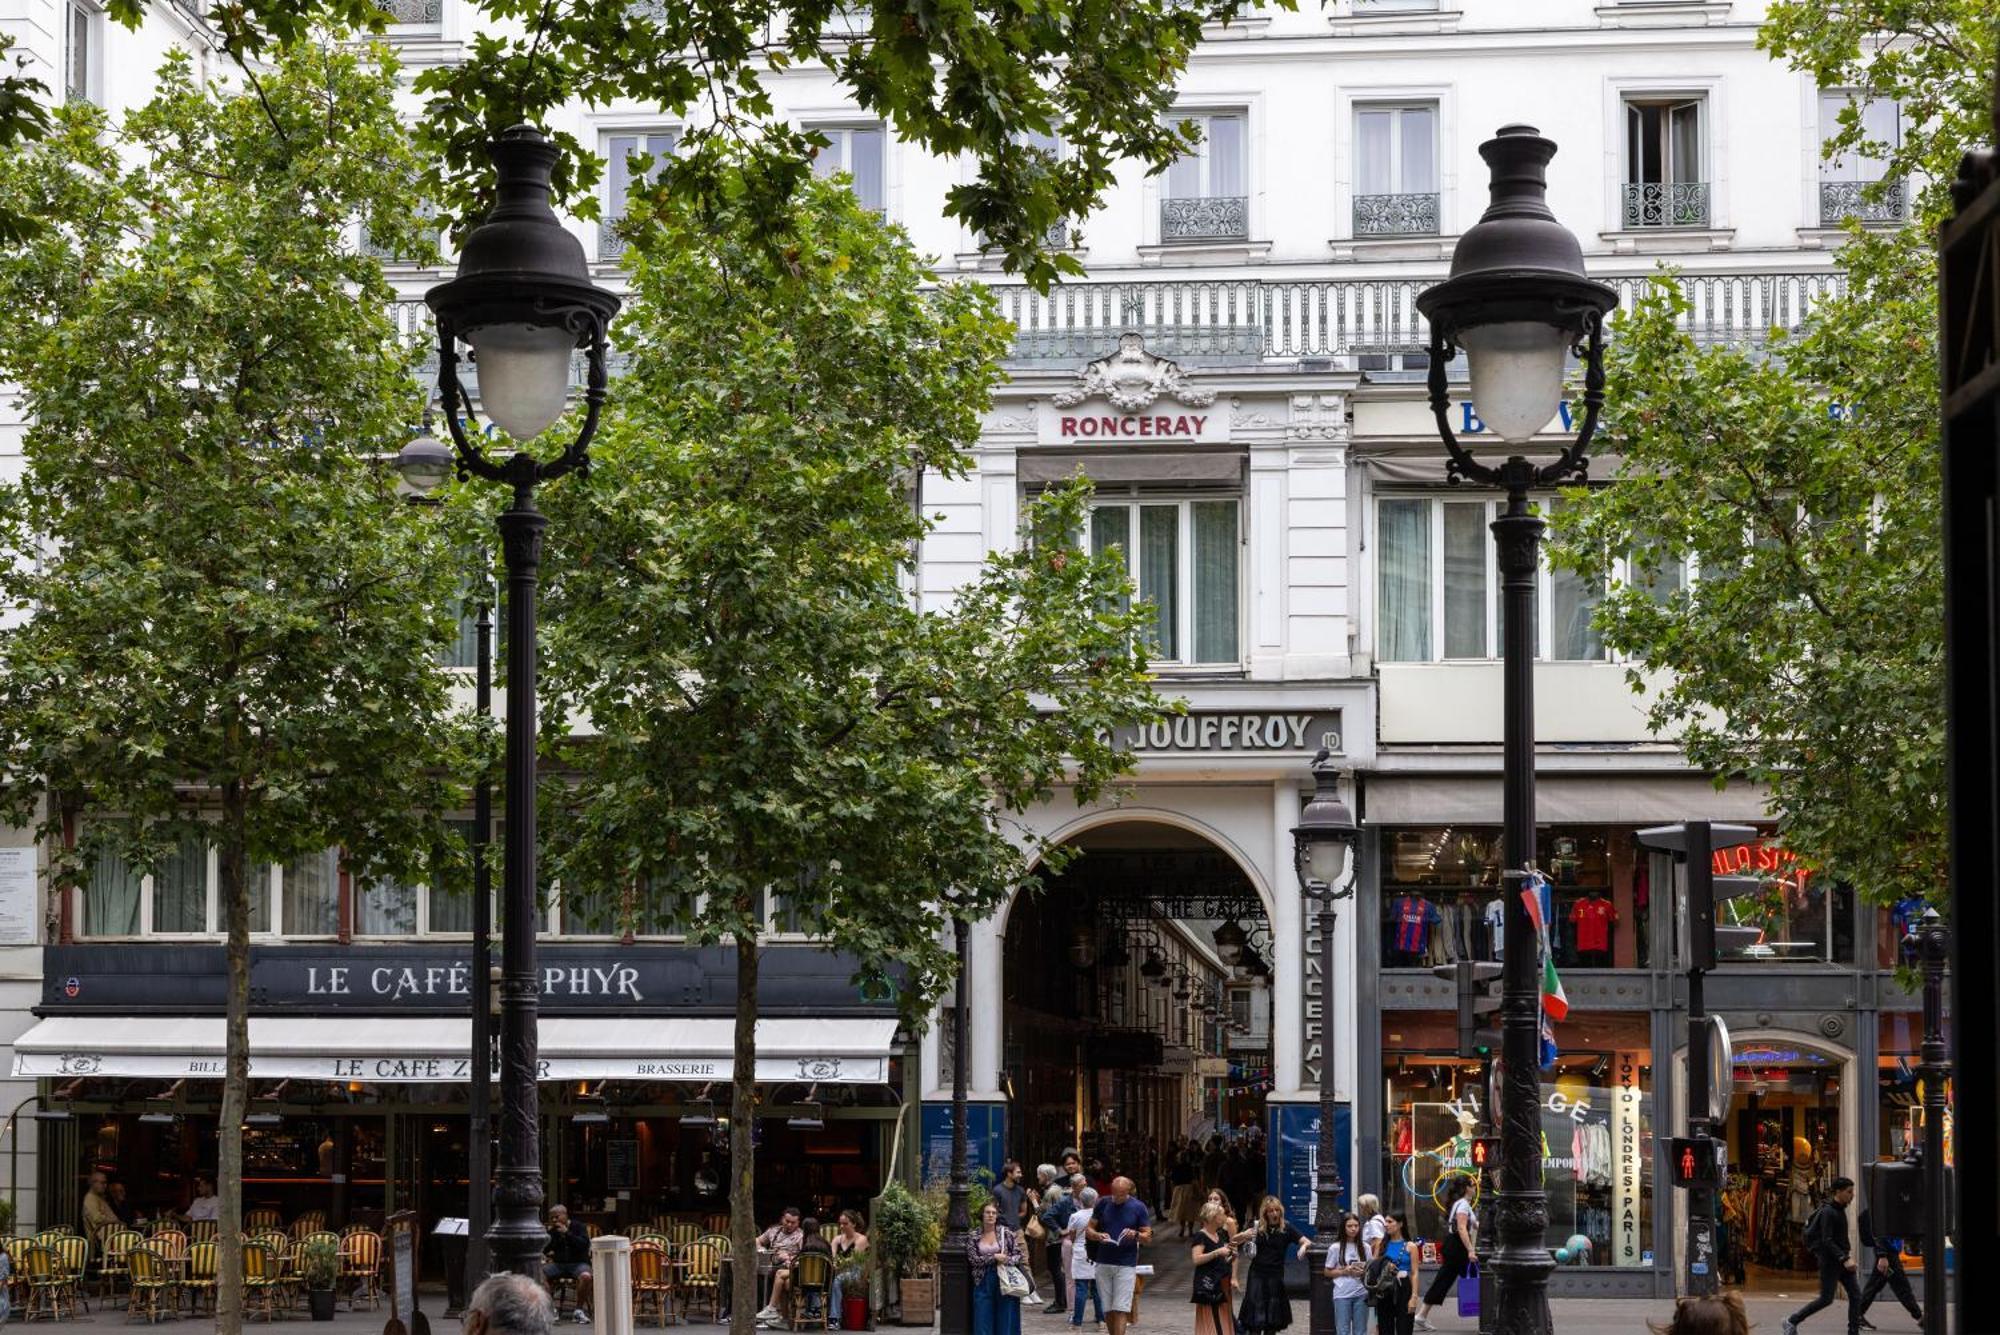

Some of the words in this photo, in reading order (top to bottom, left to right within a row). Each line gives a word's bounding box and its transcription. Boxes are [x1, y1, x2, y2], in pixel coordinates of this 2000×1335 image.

[1062, 416, 1208, 436] RONCERAY
[1127, 716, 1313, 748] JOUFFROY
[307, 967, 351, 994] LE
[371, 961, 471, 1000] CAFÉ
[542, 962, 644, 1002] PHYR
[335, 1060, 363, 1077] LE
[376, 1057, 440, 1077] CAFÉ
[637, 1063, 715, 1075] BRASSERIE
[1621, 1054, 1633, 1102] TOKYO
[1622, 1116, 1634, 1187] LONDRES
[1623, 1197, 1634, 1257] PARIS
